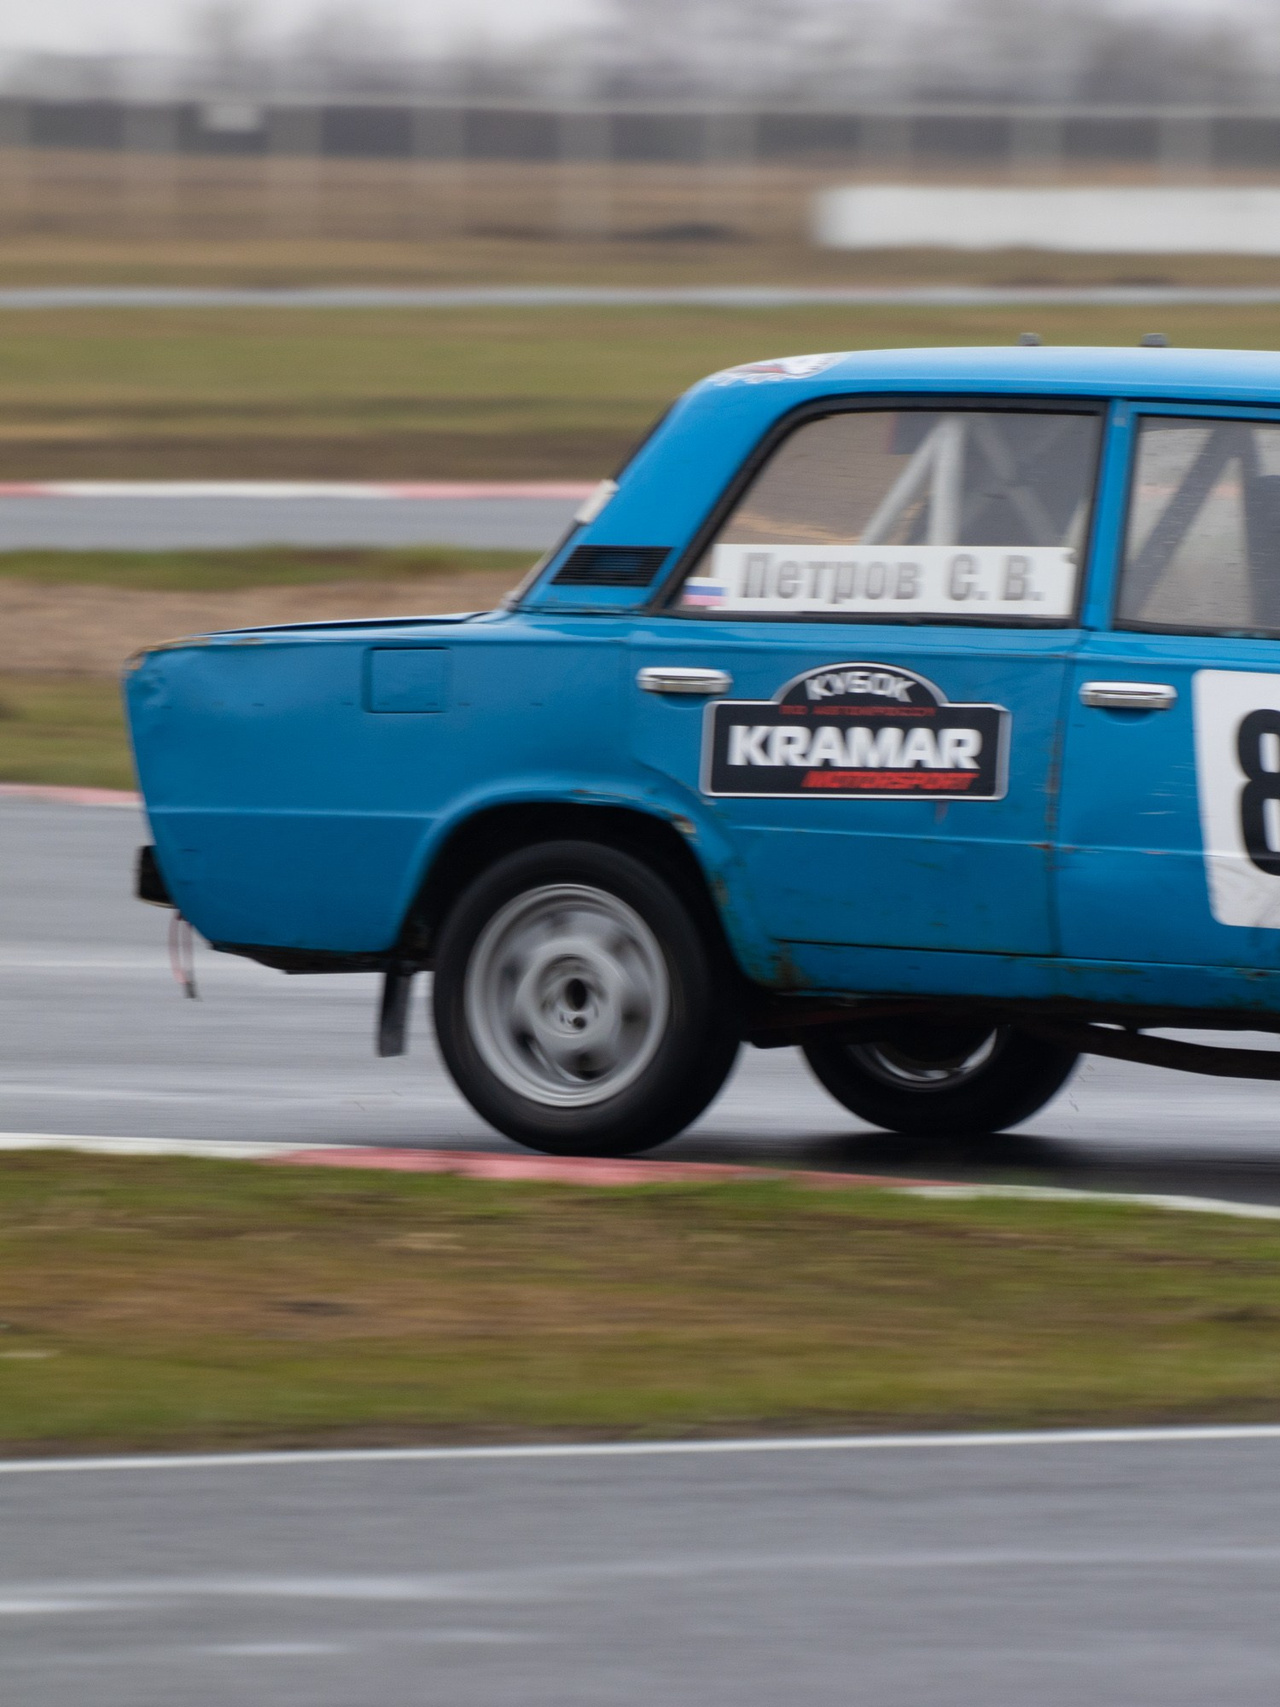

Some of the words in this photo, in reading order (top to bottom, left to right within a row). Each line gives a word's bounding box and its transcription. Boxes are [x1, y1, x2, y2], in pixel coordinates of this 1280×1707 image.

[740, 552, 921, 604] Петров
[946, 553, 988, 601] С.
[1000, 554, 1042, 601] В.
[804, 671, 917, 702] КУБОК
[727, 725, 982, 769] KRAMAR
